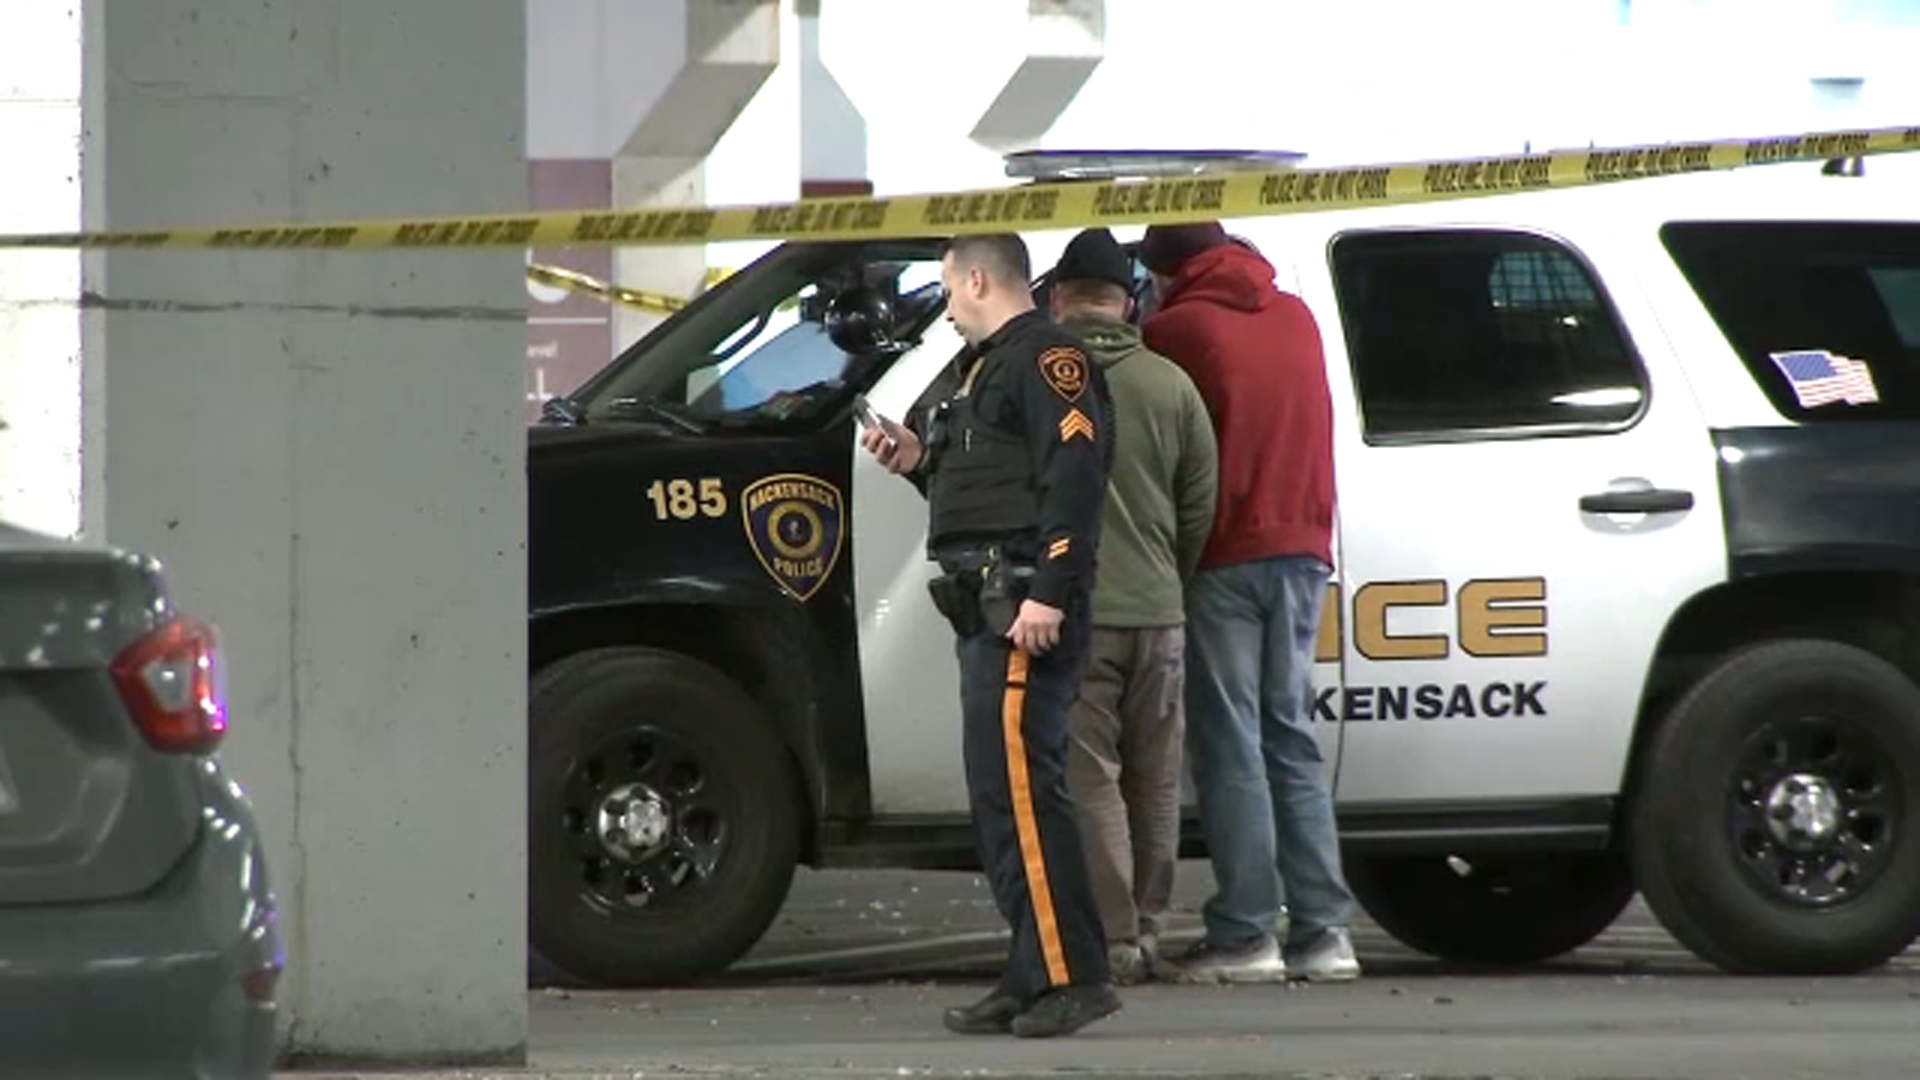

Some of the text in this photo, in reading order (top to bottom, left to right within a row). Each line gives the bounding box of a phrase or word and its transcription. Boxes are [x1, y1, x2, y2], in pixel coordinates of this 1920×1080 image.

[647, 478, 728, 519] 185
[750, 482, 835, 511] HACKENSACK
[772, 556, 823, 577] POLICE
[1314, 577, 1549, 662] ICE
[1310, 681, 1548, 722] KENSACK
